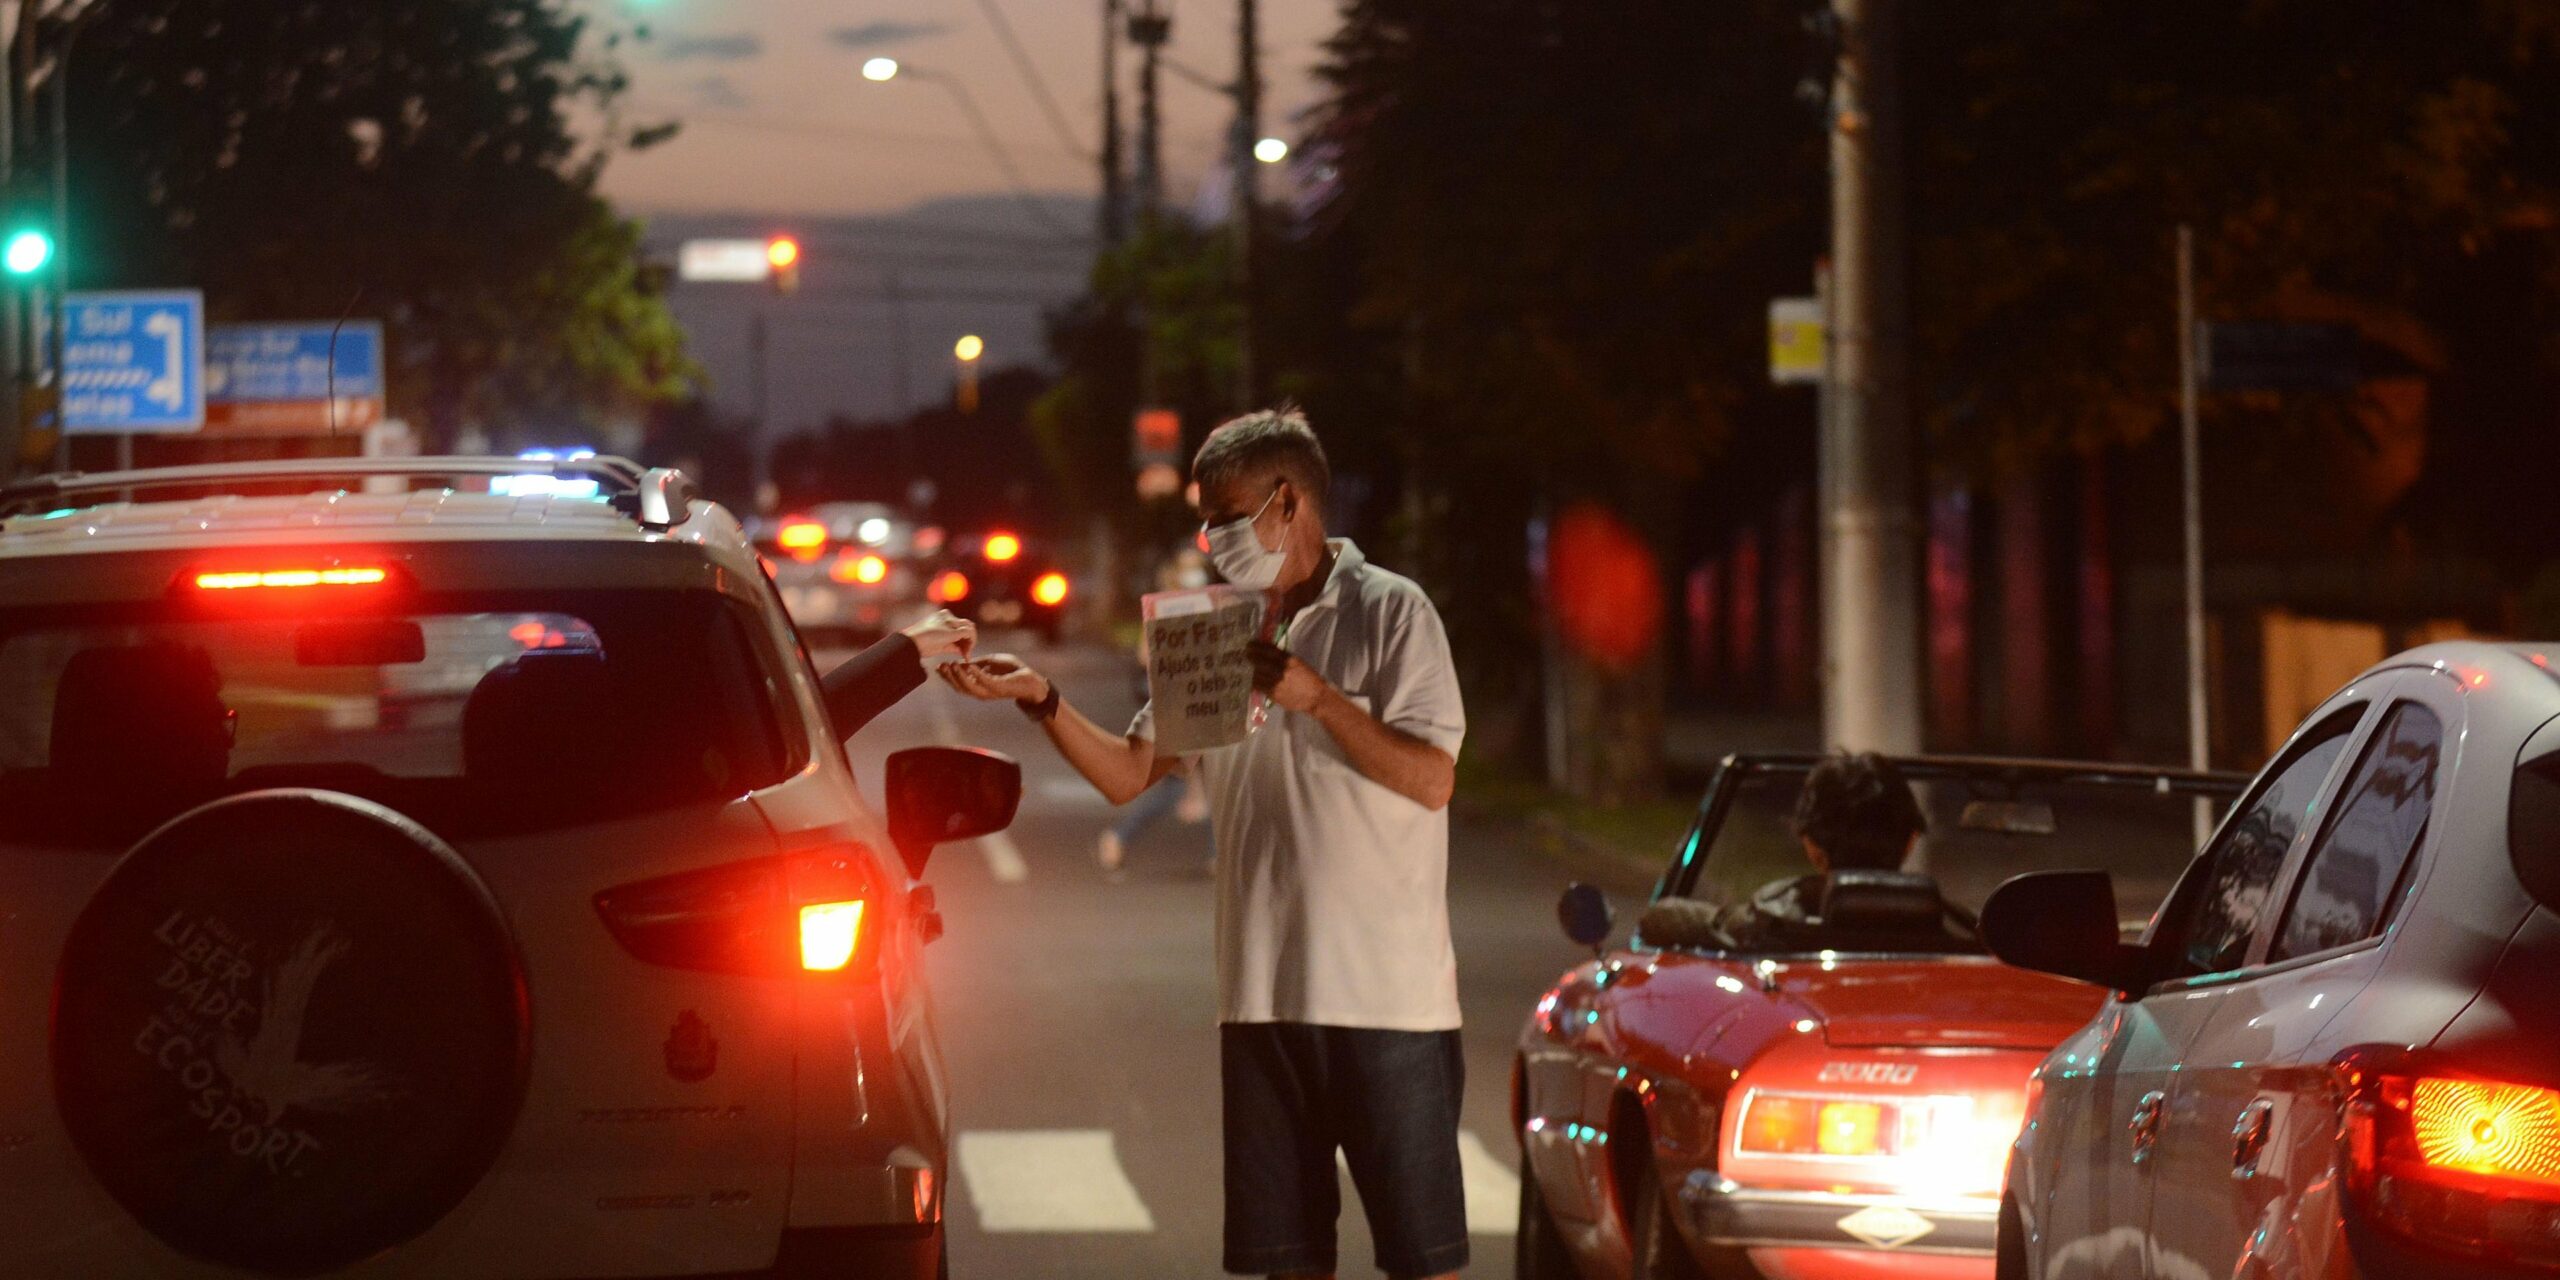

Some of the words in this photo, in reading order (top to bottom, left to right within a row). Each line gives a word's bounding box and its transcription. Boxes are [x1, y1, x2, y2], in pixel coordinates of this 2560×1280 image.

[1154, 626, 1187, 650] Por
[1158, 653, 1199, 680] Ajude
[1187, 681, 1197, 694] o
[1186, 700, 1218, 718] meu
[153, 910, 253, 998] LIBER
[155, 958, 257, 1030] DADE
